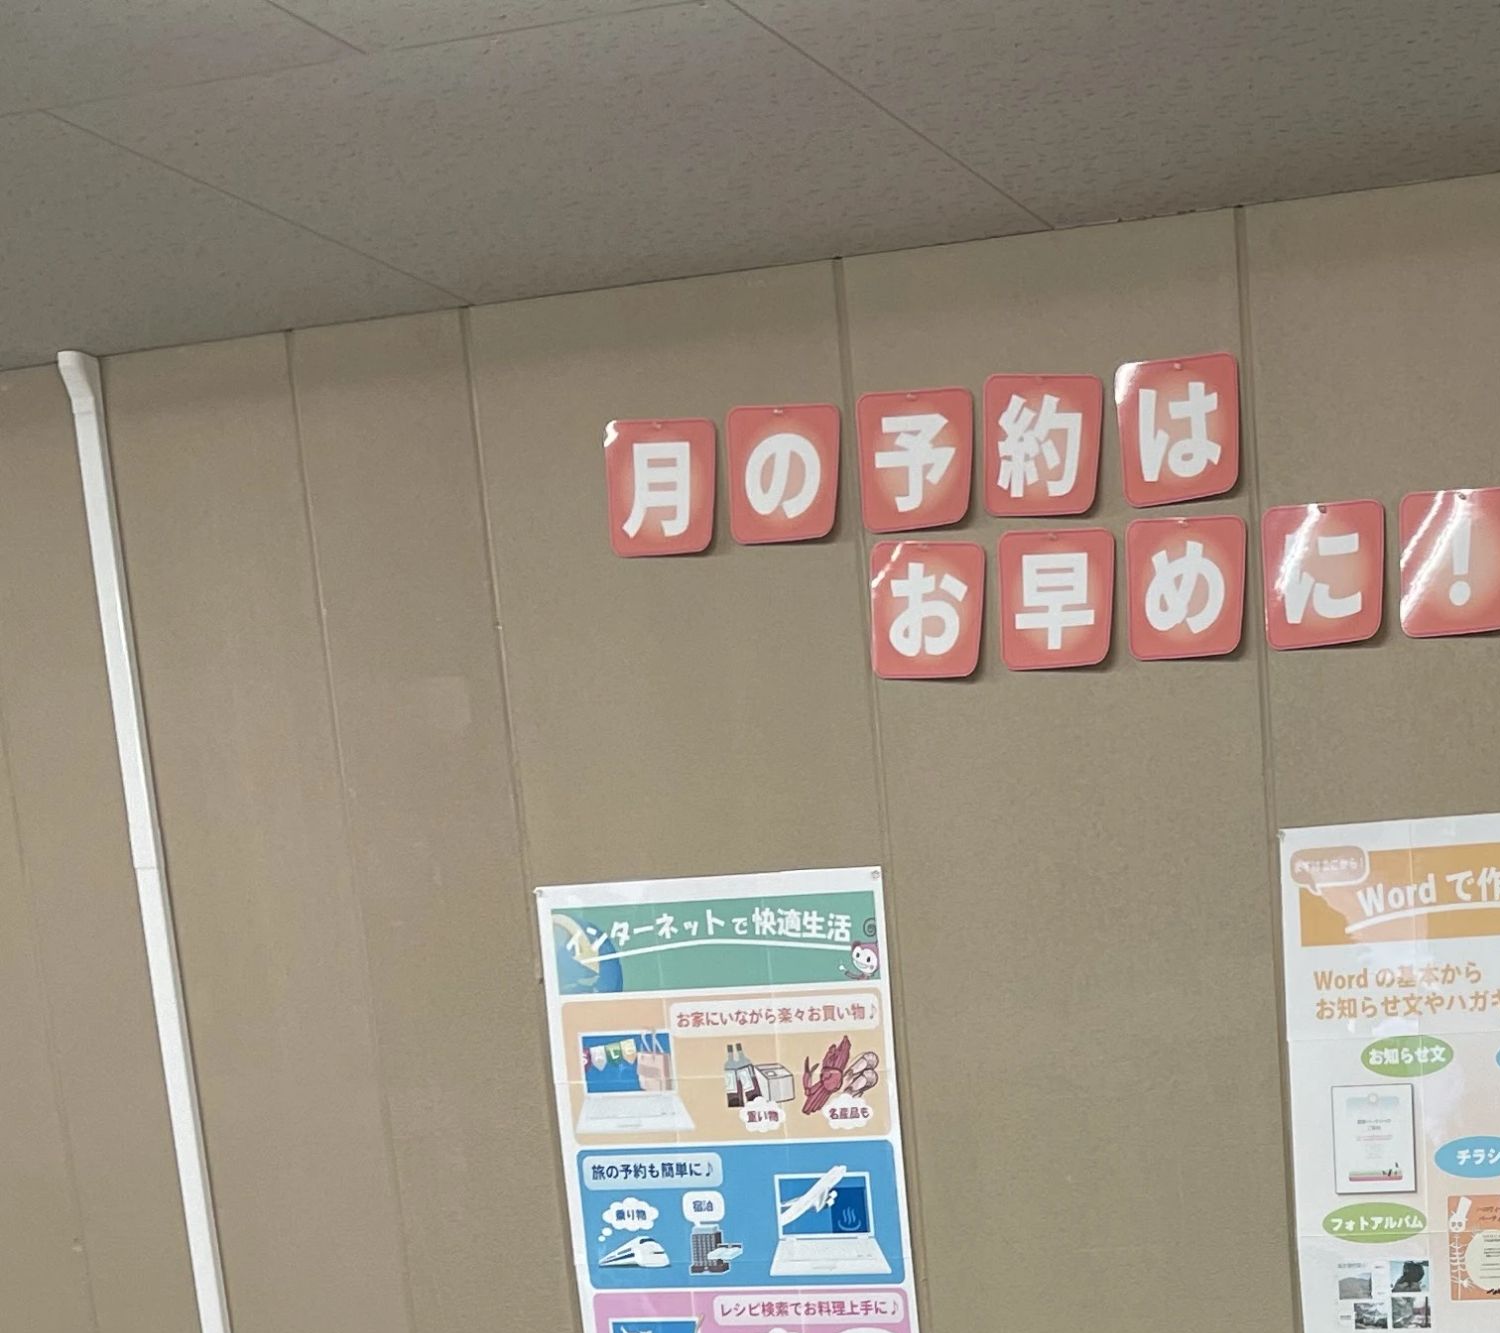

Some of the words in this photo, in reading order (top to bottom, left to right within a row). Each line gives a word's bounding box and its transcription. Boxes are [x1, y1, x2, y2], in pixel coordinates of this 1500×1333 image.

[621, 376, 1226, 540] 月の予約は
[888, 522, 1470, 659] お早めに!
[1357, 873, 1437, 918] Word
[565, 906, 853, 958] インターネットで快適生活
[1314, 968, 1369, 991] Word
[1375, 961, 1483, 990] の基本から
[676, 1003, 867, 1029] お家にいながら楽々お買い物
[1368, 1046, 1447, 1066] お知らせ文
[828, 1106, 871, 1122] 名産品も
[592, 1161, 703, 1181] 旅の予約も簡単に
[1330, 1215, 1424, 1231] フォトアルバム
[720, 1298, 891, 1319] レシピ検索でお料理上手に
